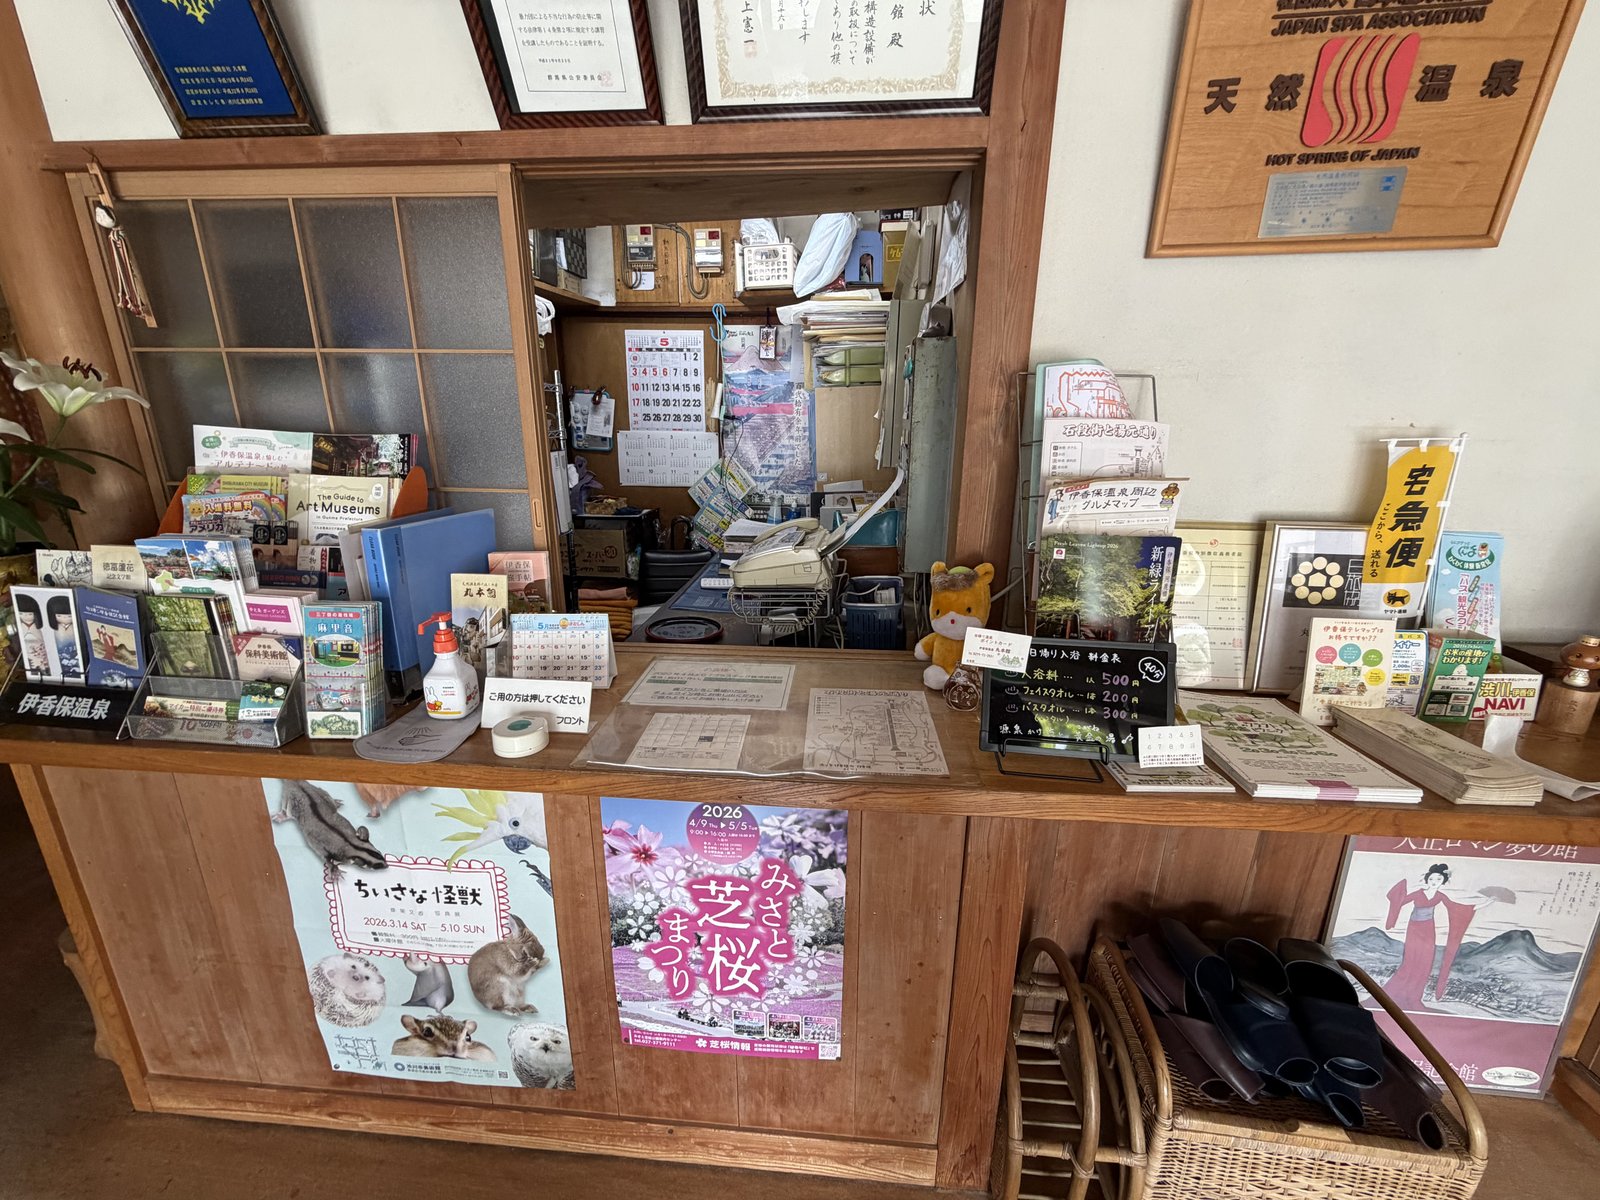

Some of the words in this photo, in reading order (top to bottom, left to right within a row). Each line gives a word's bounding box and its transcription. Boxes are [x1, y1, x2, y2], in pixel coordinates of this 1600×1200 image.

[1271, 17, 1329, 36] JAPAN
[1331, 16, 1364, 32] SPA
[1367, 6, 1488, 30] ASSOCIATION
[1265, 153, 1296, 167] HOT
[1297, 151, 1348, 166] SPRING
[1350, 150, 1369, 163] OF
[1371, 146, 1420, 162] JAPAN
[660, 338, 669, 347] 5
[684, 353, 687, 361] 1
[693, 353, 698, 361] 2
[632, 368, 637, 376] 3
[642, 368, 647, 376] 4
[652, 368, 657, 376] 5
[662, 368, 667, 376] 6
[673, 368, 678, 376] 7
[683, 368, 688, 376] 8
[694, 368, 698, 376] 9
[632, 383, 639, 392] 10
[642, 383, 649, 392] 11
[652, 383, 659, 392] 12
[662, 383, 670, 392] 13
[672, 383, 680, 392] 14
[682, 383, 690, 392] 15
[693, 383, 700, 392] 16
[632, 398, 639, 407] 17
[642, 398, 650, 407] 18
[653, 398, 660, 407] 19
[662, 398, 670, 407] 20
[672, 398, 680, 407] 21
[682, 398, 690, 407] 22
[692, 398, 701, 407] 23
[643, 414, 651, 422] 25
[653, 414, 661, 422] 26
[663, 414, 671, 422] 27
[672, 414, 681, 422] 28
[683, 414, 691, 422] 29
[693, 414, 701, 422] 30
[1063, 423, 1157, 439] 石段街と湯元通り
[333, 493, 355, 502] Guide
[1069, 486, 1158, 500] 伊香保温泉周辺
[296, 501, 319, 512] Art
[321, 502, 380, 515] Museums
[1082, 498, 1140, 510] グルメマップ
[1385, 464, 1436, 568] 宅急便
[1369, 549, 1381, 578] 送れる
[463, 587, 497, 599] 丸本館
[245, 649, 289, 661] 保科美術館
[1029, 648, 1081, 661] 日帰り入浴
[1443, 648, 1488, 657] お米の産地が
[1022, 686, 1074, 698] フェイスタオル
[488, 692, 586, 705] ご用の方は押してください
[1484, 698, 1526, 710] NAVI
[16, 692, 112, 720] 伊香保温泉
[1022, 702, 1065, 713] バスタオル
[556, 716, 585, 726] フロント
[702, 804, 743, 819] 2026
[689, 819, 708, 828] 4/9
[728, 821, 747, 831] 5/5
[354, 879, 483, 906] ちいさな怪獣
[759, 863, 796, 959] みさと
[364, 917, 408, 929] 2026.3.14
[411, 923, 427, 931] SAT
[440, 923, 460, 933] 5.10
[463, 925, 485, 934] SUN
[692, 879, 762, 993] 芝桜
[650, 912, 691, 997] まつり
[709, 1040, 751, 1051] 芝桜情報
